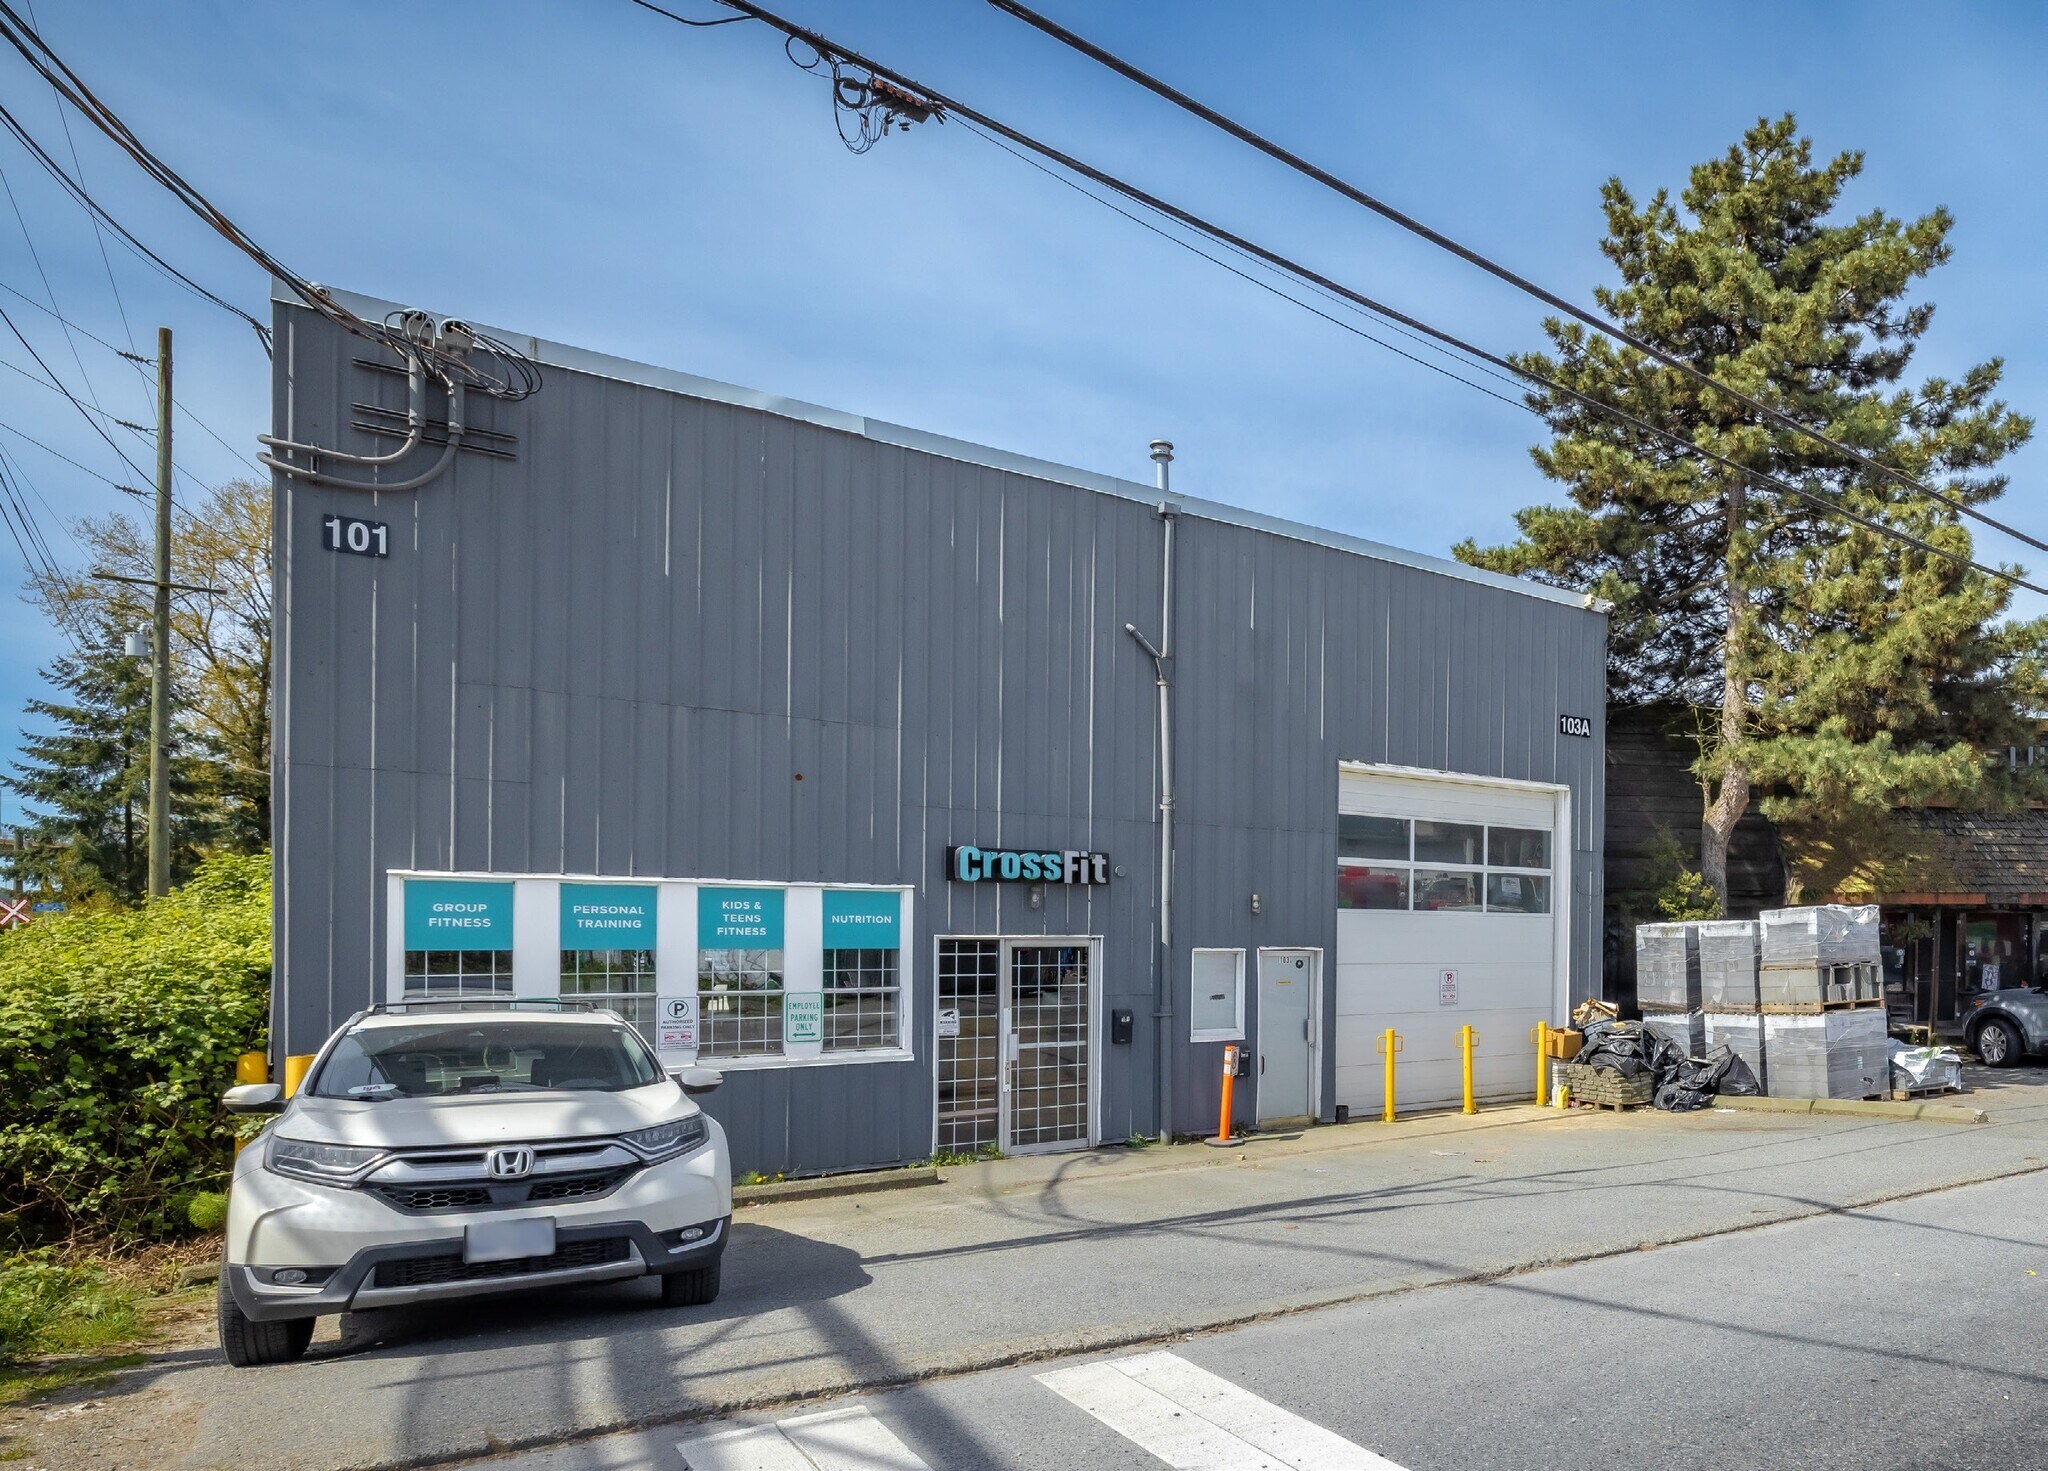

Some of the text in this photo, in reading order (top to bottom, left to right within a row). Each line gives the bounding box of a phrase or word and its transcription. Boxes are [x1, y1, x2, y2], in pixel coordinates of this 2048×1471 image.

[325, 518, 387, 555] 101
[1561, 716, 1590, 736] 103A
[955, 845, 1107, 884] CrossFit
[432, 903, 488, 913] GROUP
[573, 905, 646, 915] PERSONAL
[722, 901, 762, 910] KIDS &
[428, 917, 492, 928] FITNESS
[723, 914, 762, 923] TEENS
[831, 915, 893, 924] NUTRITION
[577, 919, 642, 929] TRAINING
[717, 927, 767, 936] FITNESS
[674, 1002, 685, 1016] P
[788, 1002, 820, 1010] EMPLOYEE
[790, 1013, 819, 1022] PARKING
[795, 1022, 813, 1031] ONLY
